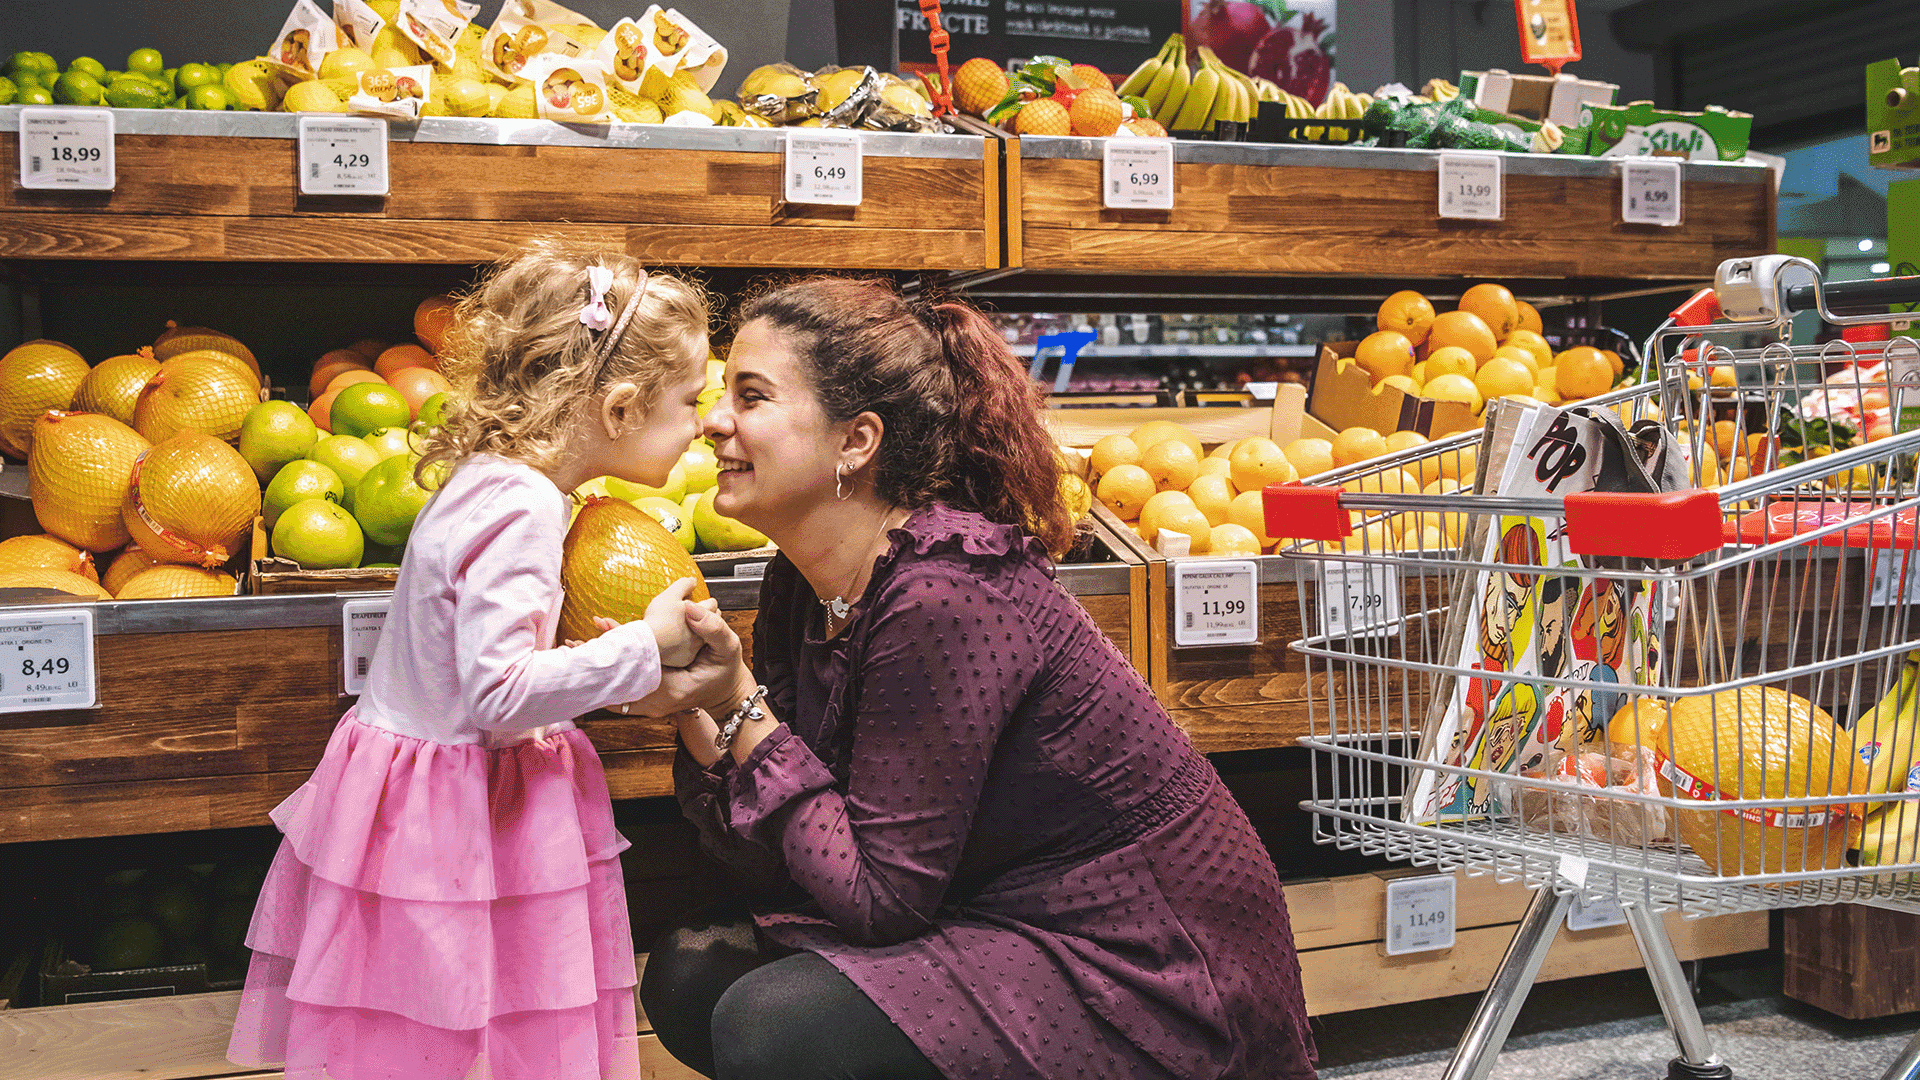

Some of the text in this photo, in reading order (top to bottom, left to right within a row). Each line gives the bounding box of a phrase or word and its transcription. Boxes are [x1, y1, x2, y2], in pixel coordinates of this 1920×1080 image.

[896, 8, 990, 35] FRCTE
[367, 75, 389, 87] 365
[577, 93, 598, 108] 365
[51, 147, 101, 163] 18,99
[333, 154, 369, 169] 4,29
[814, 166, 846, 180] 6,49
[1130, 173, 1159, 186] 6,99
[1460, 184, 1491, 197] 13,99
[1526, 411, 1587, 494] POP
[1202, 600, 1246, 617] 11,99
[22, 657, 70, 678] 8,49
[1409, 910, 1445, 927] 11,49
